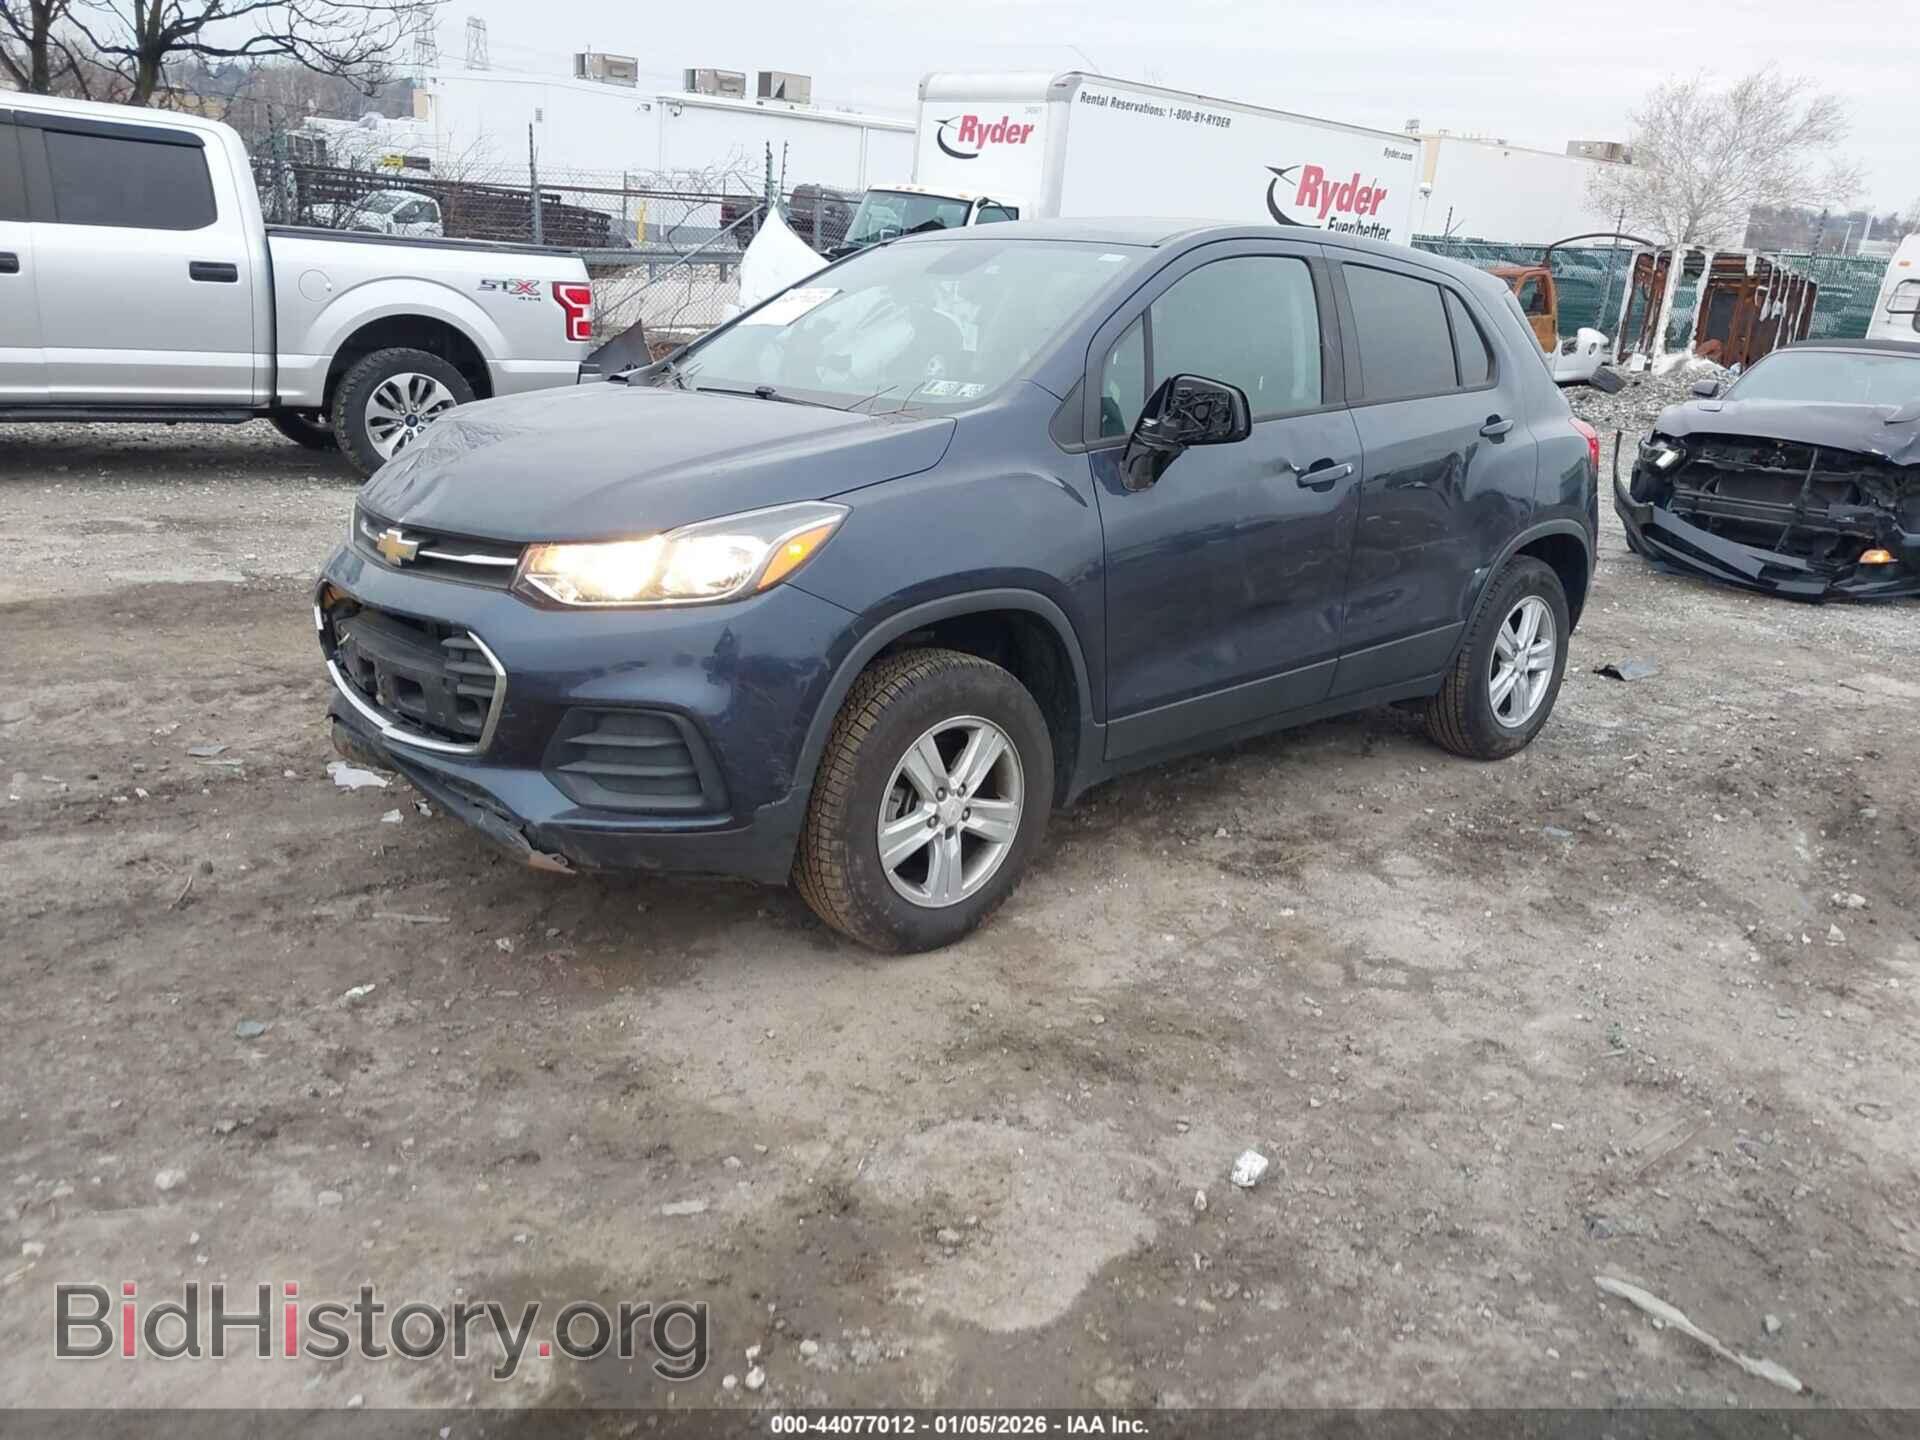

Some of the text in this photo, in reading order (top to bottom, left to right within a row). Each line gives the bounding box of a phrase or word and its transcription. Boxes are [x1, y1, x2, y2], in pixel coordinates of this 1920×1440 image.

[1080, 91, 1232, 128] Rental Reservations: 1-800-BY-RYDER
[958, 115, 1034, 149] Ryder
[1383, 147, 1413, 161] Ryder.com
[1295, 164, 1388, 220] Ryder
[477, 279, 541, 295] STX
